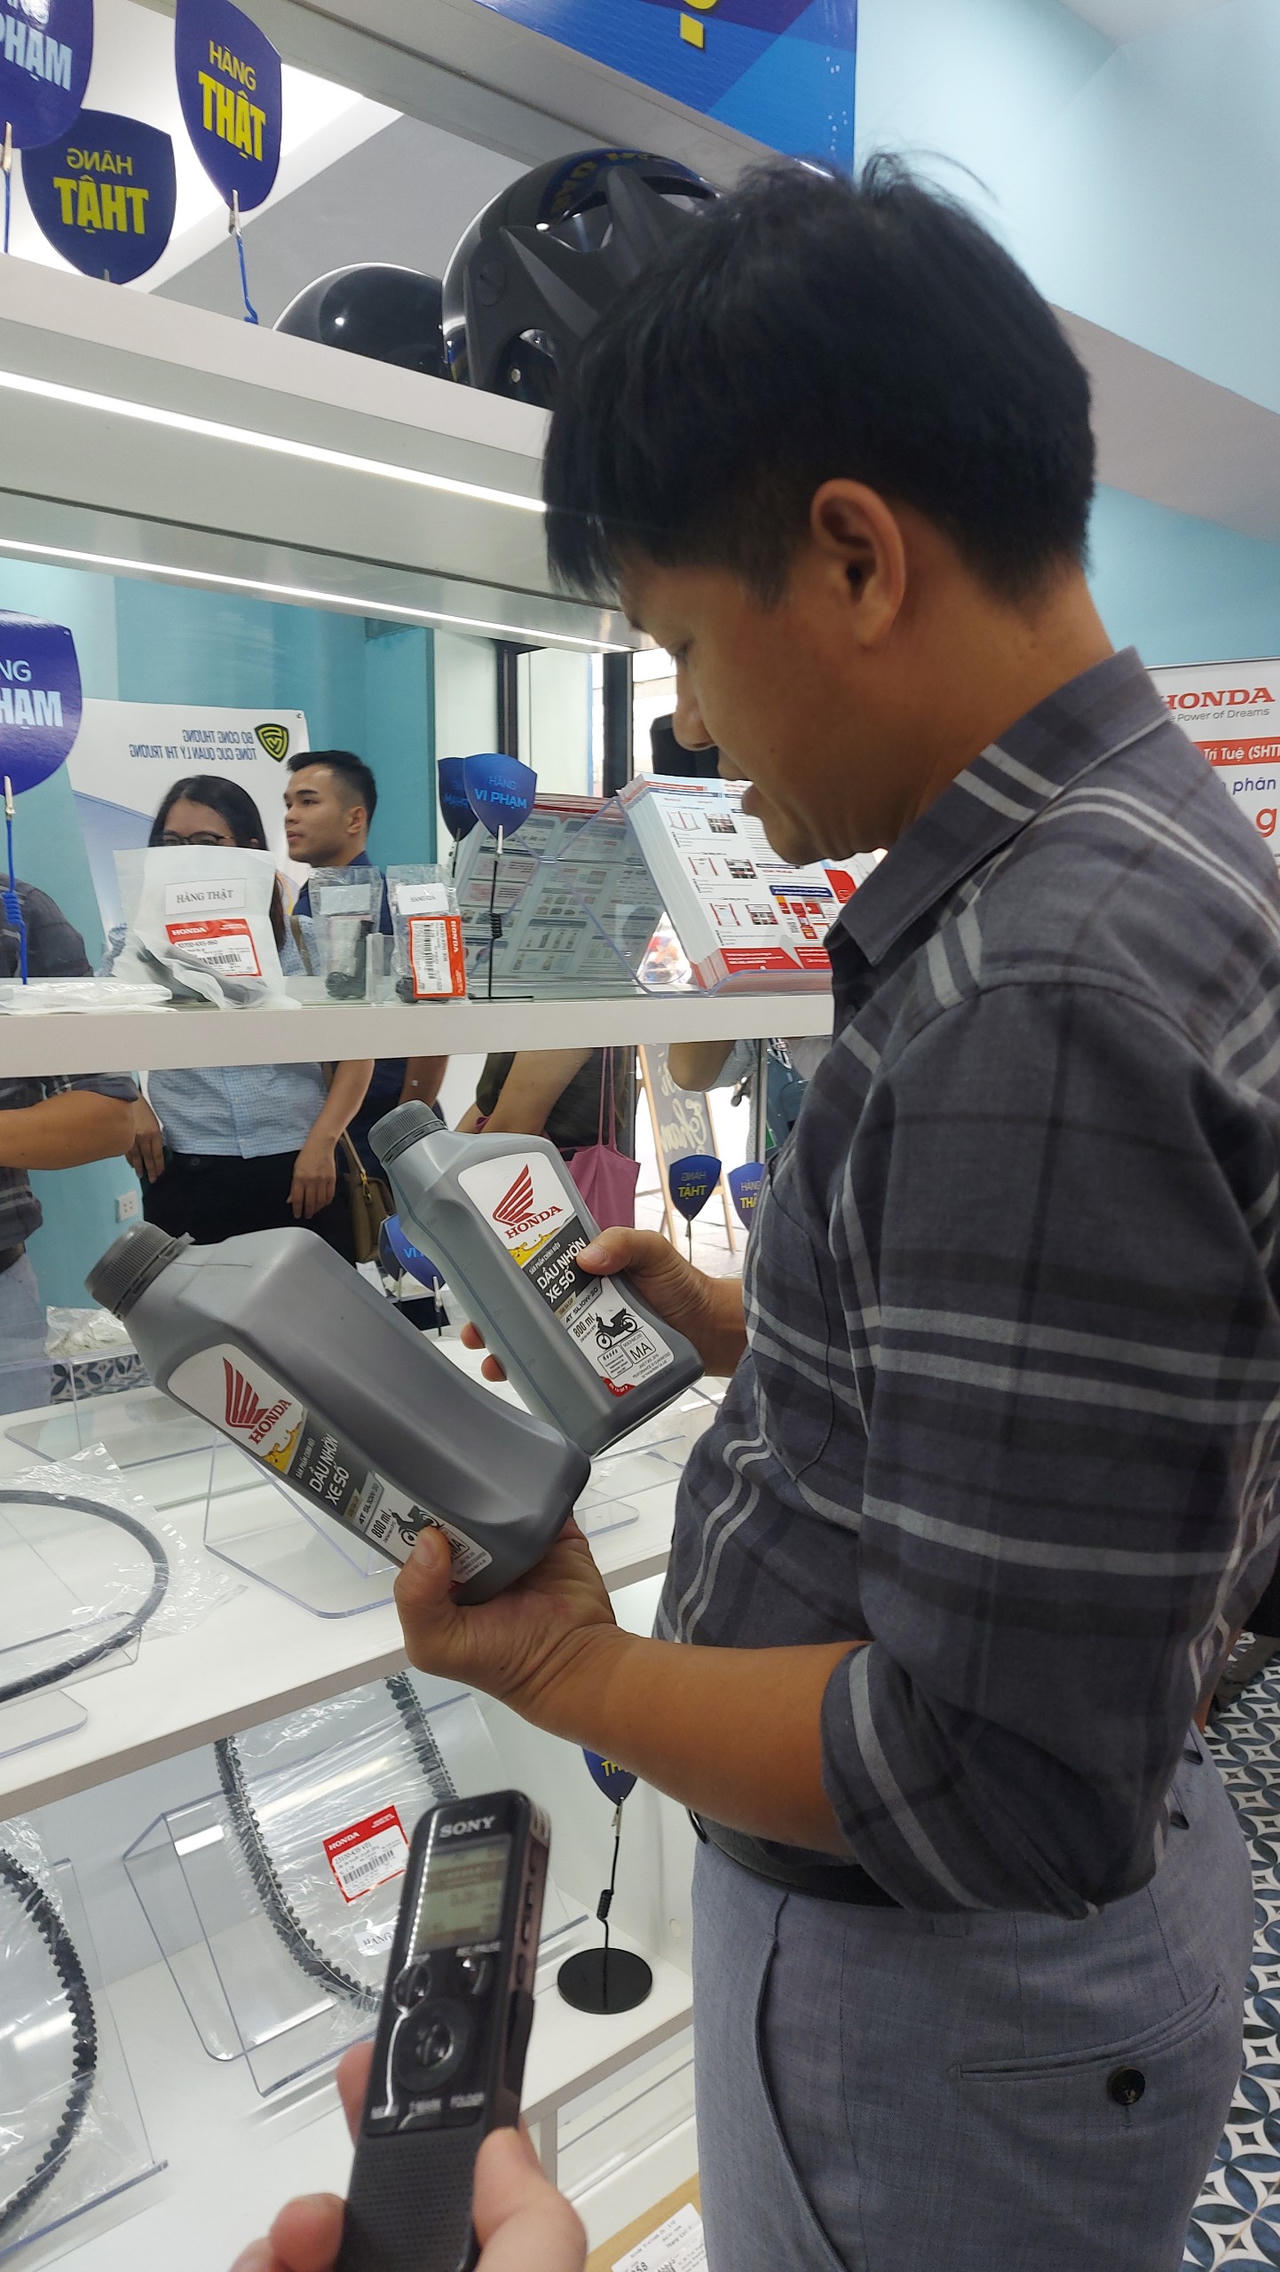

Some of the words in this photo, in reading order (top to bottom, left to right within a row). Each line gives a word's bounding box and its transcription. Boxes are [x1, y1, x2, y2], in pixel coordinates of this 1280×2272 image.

[209, 40, 257, 91] HÀNG
[198, 70, 266, 161] THẬT
[1177, 713, 1211, 723] Power
[1213, 710, 1225, 719] of
[1227, 708, 1270, 719] Dreams
[1220, 747, 1244, 762] Tuệ
[474, 788, 488, 801] VI
[490, 791, 527, 809] PHẠM
[450, 920, 459, 952] HONDA
[504, 1205, 563, 1239] HONDA
[546, 1284, 562, 1303] XE
[559, 1265, 576, 1290] SỐ
[572, 1320, 587, 1338] 800
[585, 1313, 596, 1326] ml
[629, 1342, 653, 1361] MA
[248, 1399, 292, 1445] HONDA
[333, 1460, 350, 1488] SỐ
[325, 1483, 343, 1506] XE
[371, 1519, 387, 1539] 800
[380, 1509, 392, 1525] ml
[439, 1816, 496, 1838] SONY
[328, 1831, 360, 1850] HONDA
